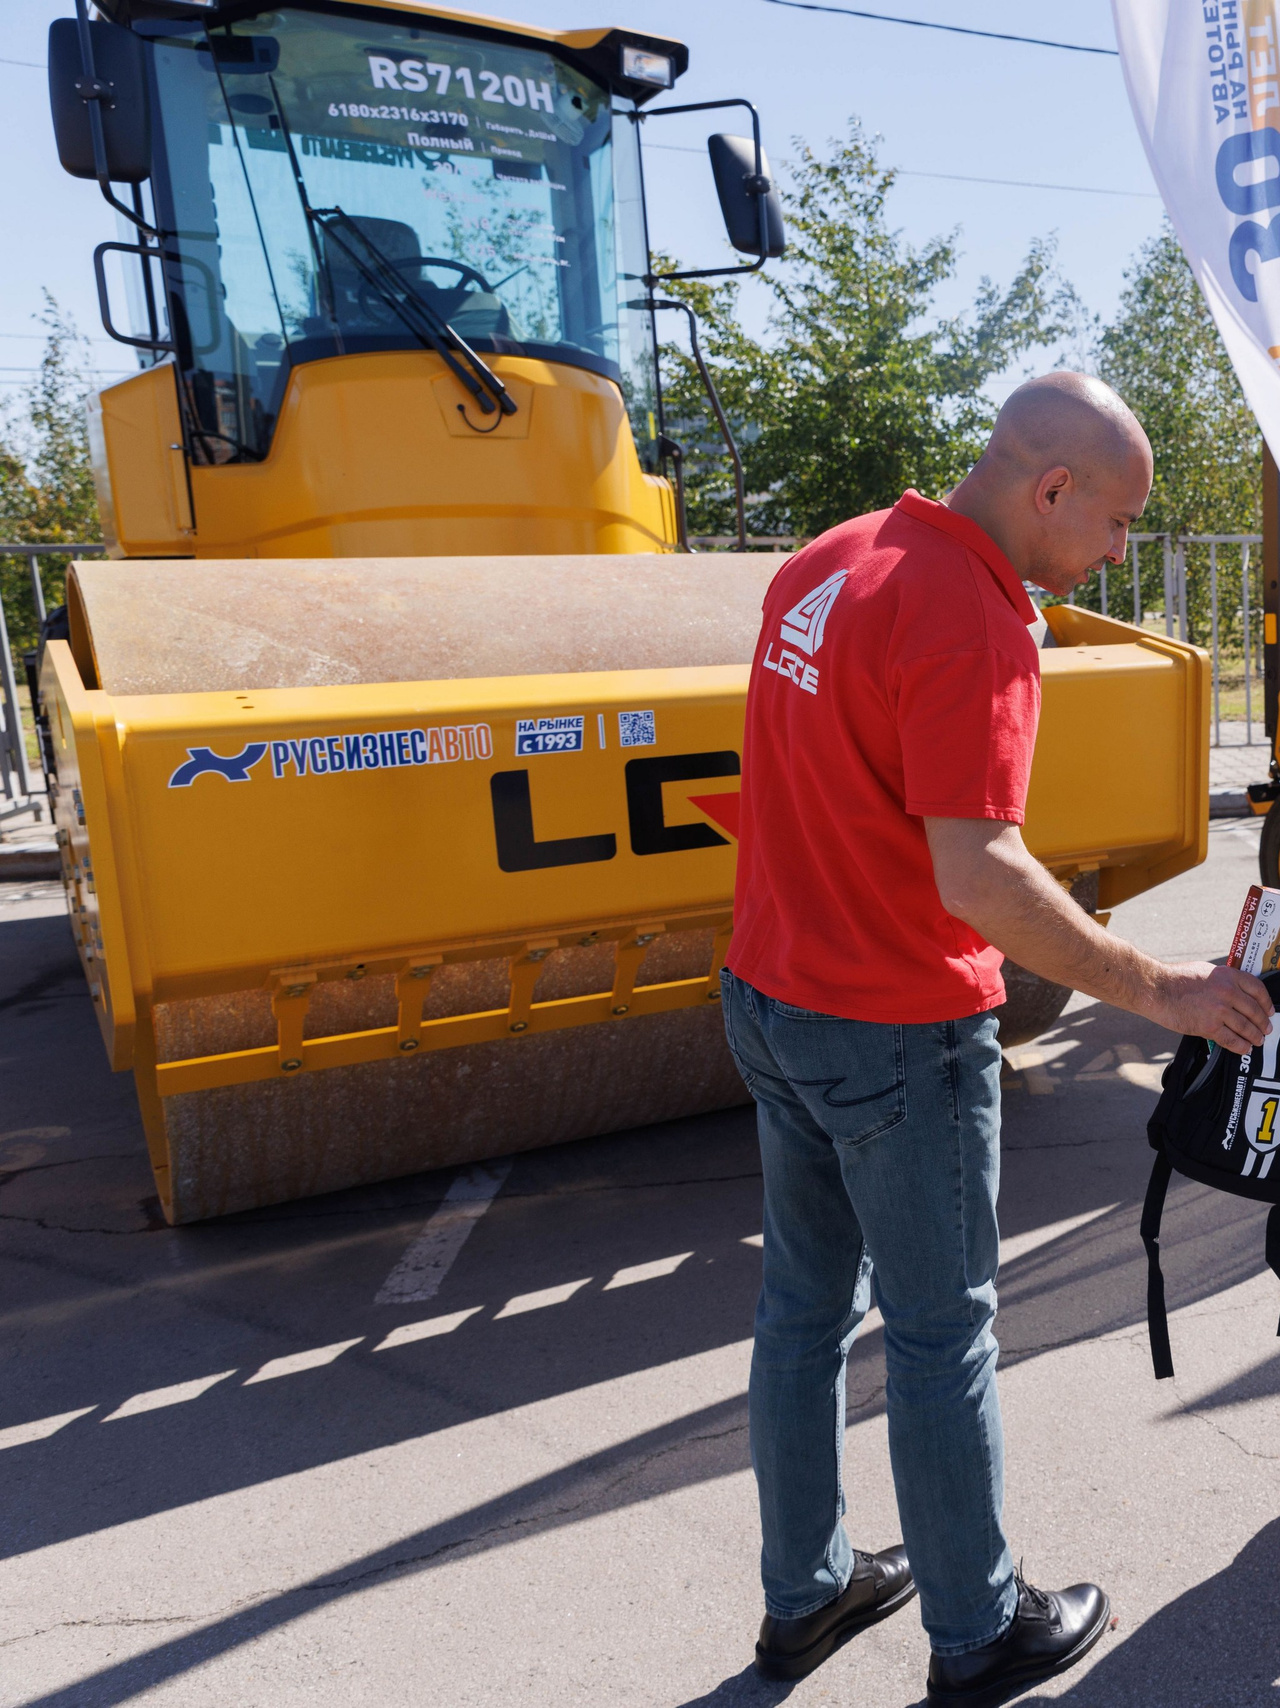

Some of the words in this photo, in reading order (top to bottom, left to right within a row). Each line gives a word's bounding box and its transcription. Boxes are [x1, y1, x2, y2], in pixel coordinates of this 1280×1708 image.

[367, 55, 555, 114] RS7120H
[407, 132, 474, 151] Полный
[763, 642, 819, 695] LGCE
[518, 720, 536, 732] НА
[538, 717, 583, 731] РЫНКЕ
[270, 723, 493, 778] РУСБИЗНЕСАВТО
[1249, 896, 1258, 912] НА
[1263, 902, 1273, 915] 5+
[1234, 914, 1253, 959] СТРОЙКЕ
[1240, 1054, 1251, 1074] 30
[1228, 1076, 1245, 1129] РУСБИЗНЕСАВТО
[1256, 1096, 1280, 1145] 1
